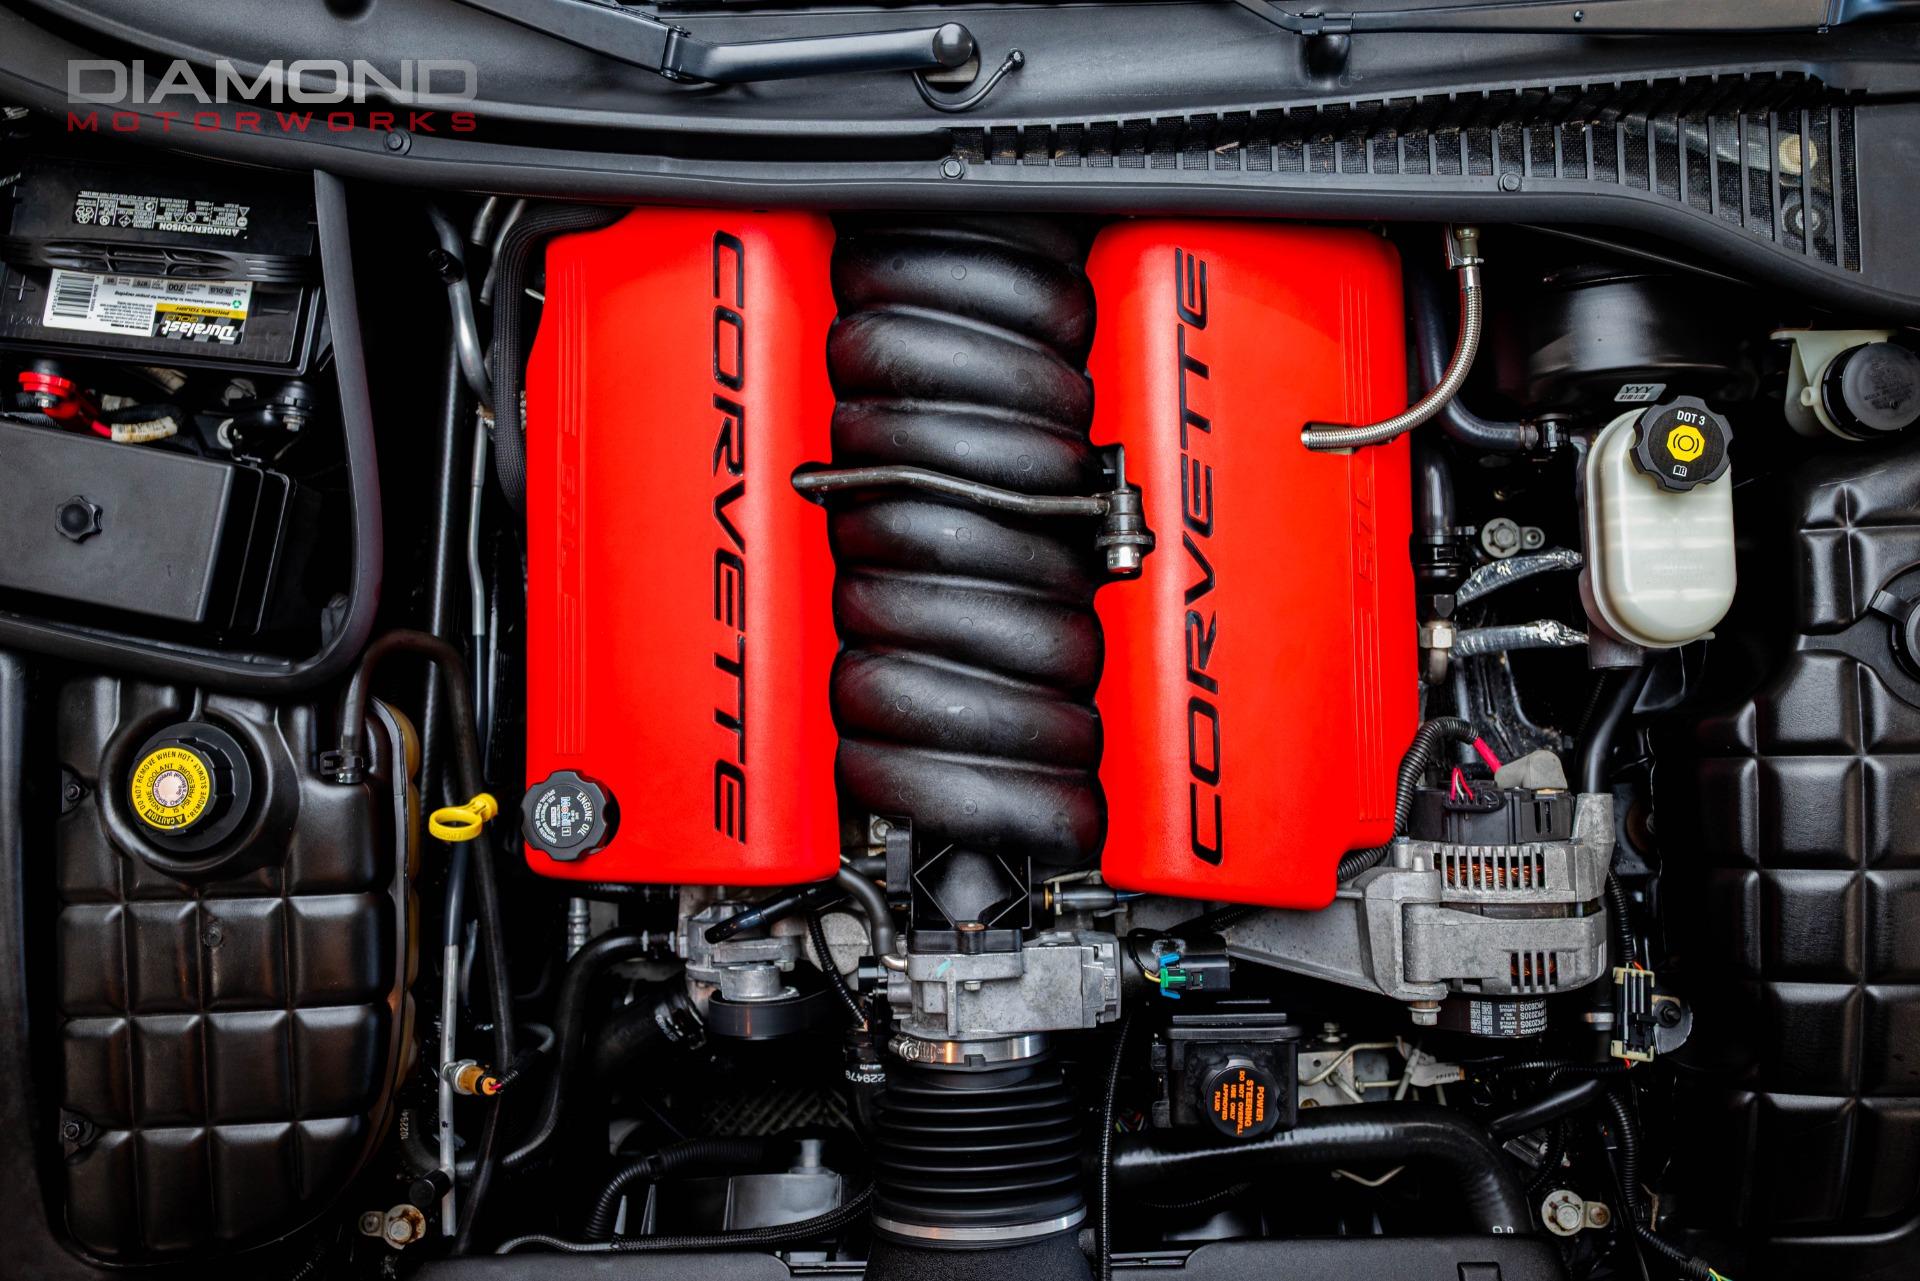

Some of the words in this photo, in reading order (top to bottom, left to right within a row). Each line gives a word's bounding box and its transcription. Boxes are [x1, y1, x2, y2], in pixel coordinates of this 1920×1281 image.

[159, 222, 231, 234] DANGER/POISON
[168, 284, 184, 292] 700
[165, 314, 198, 323] GOLD
[161, 321, 235, 341] Duralast
[1676, 410, 1697, 424] DOT
[1698, 415, 1706, 426] 3
[713, 230, 747, 844] CORVETTE
[1175, 247, 1223, 866] CORVETTE
[156, 752, 176, 760] WHEN
[136, 758, 155, 783] REMOVE
[146, 764, 173, 788] COOLANT
[178, 764, 195, 798] PRESSURE
[192, 764, 207, 789] SLOWLY
[138, 800, 146, 810] DO
[146, 790, 164, 813] ENGINE
[182, 800, 190, 810] PSI
[190, 792, 206, 818] REMOVE
[576, 792, 592, 822] ENGINE
[146, 810, 175, 824] CAUTION
[577, 824, 590, 837] OIL
[1239, 1070, 1246, 1081] DO
[1244, 1080, 1254, 1127] STEERING
[1256, 1086, 1265, 1122] POWER
